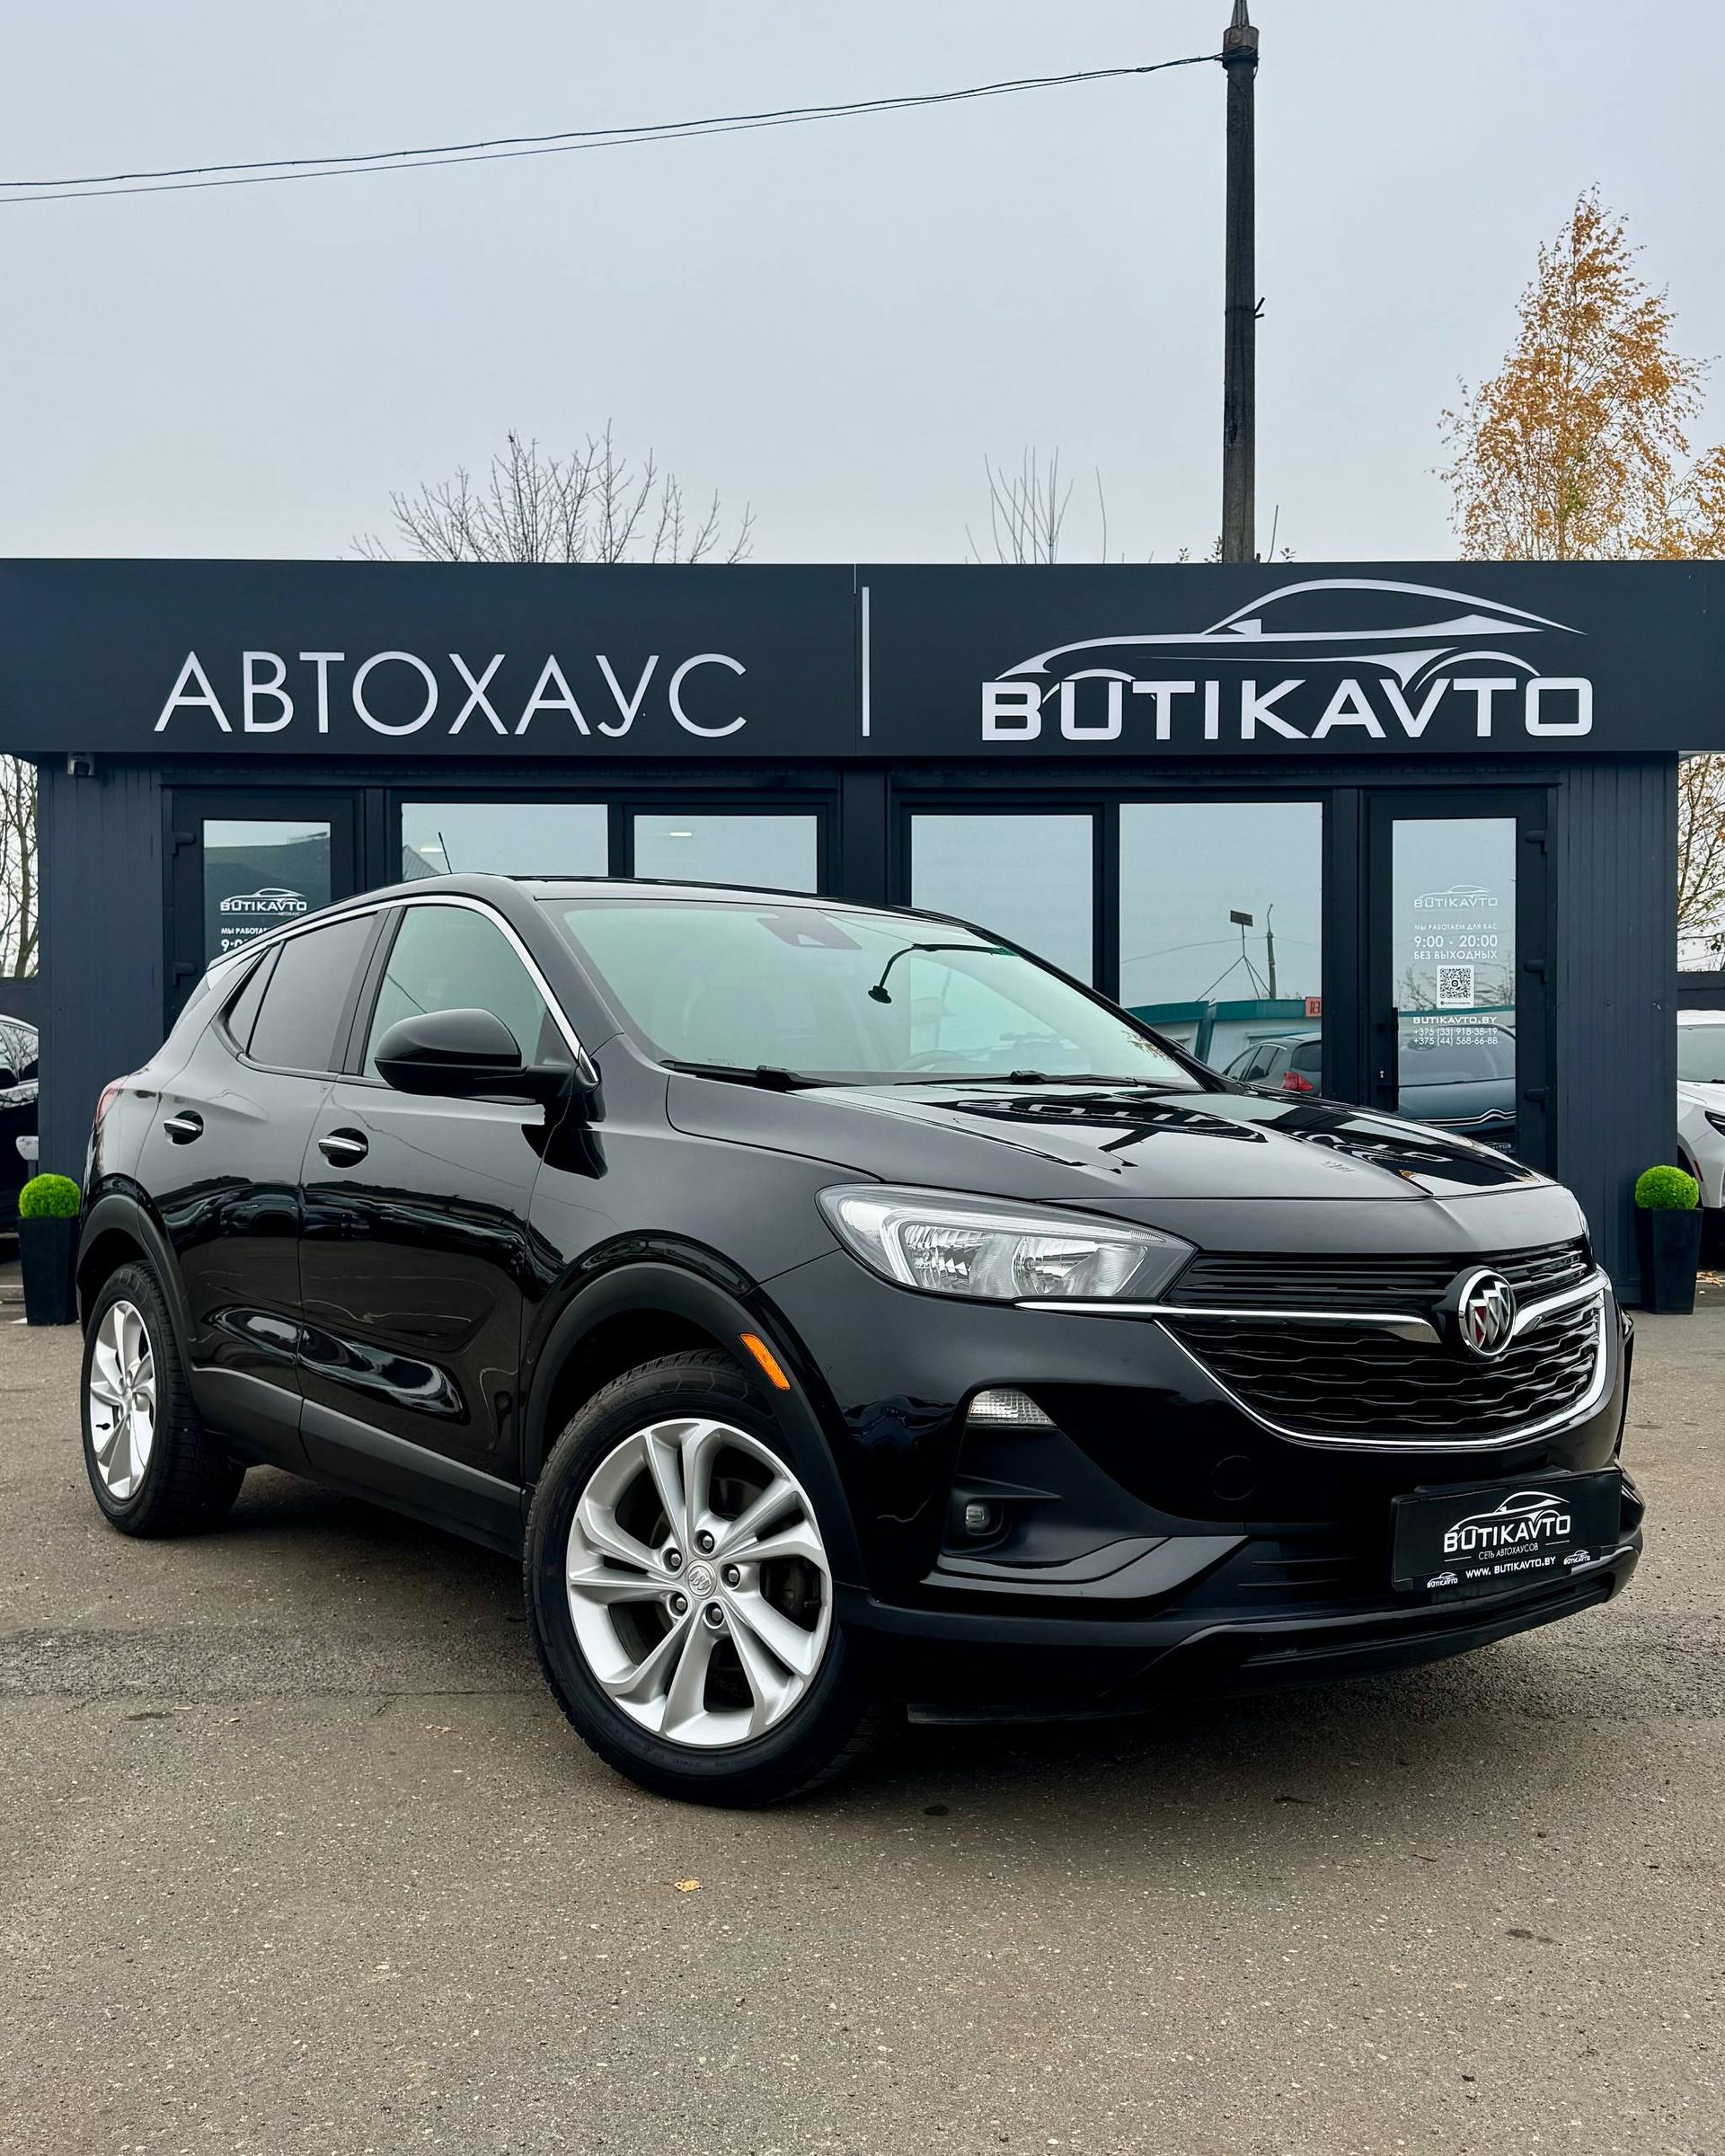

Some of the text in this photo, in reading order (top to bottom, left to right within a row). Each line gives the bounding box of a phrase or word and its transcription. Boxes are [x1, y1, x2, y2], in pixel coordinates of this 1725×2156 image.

[154, 650, 748, 738] АВТОХАУС
[981, 676, 1594, 742] BUTIKAVTO
[220, 901, 307, 912] BUTIKAVTO
[1414, 897, 1498, 908] BUTIKAVTO
[221, 927, 234, 935] МЫ
[1414, 936, 1444, 948] 9:00
[1459, 935, 1498, 947] 20:00
[1414, 950, 1498, 960] БЕЗ ВЫХОДНЫХ
[1413, 1016, 1498, 1024] BUTIKAVTO.BY
[1413, 1027, 1498, 1038] +375 (33) 918-38-19
[1413, 1037, 1498, 1047] +375 (44) 568-66-88
[1443, 1515, 1570, 1553] BUTIKAVTO
[1478, 1542, 1539, 1560] СЕТЬ АВТОХАУСОВ
[1465, 1556, 1556, 1579] WWW. BUTIKAVTO.BY
[1427, 1577, 1458, 1588] BUTIKAVTO
